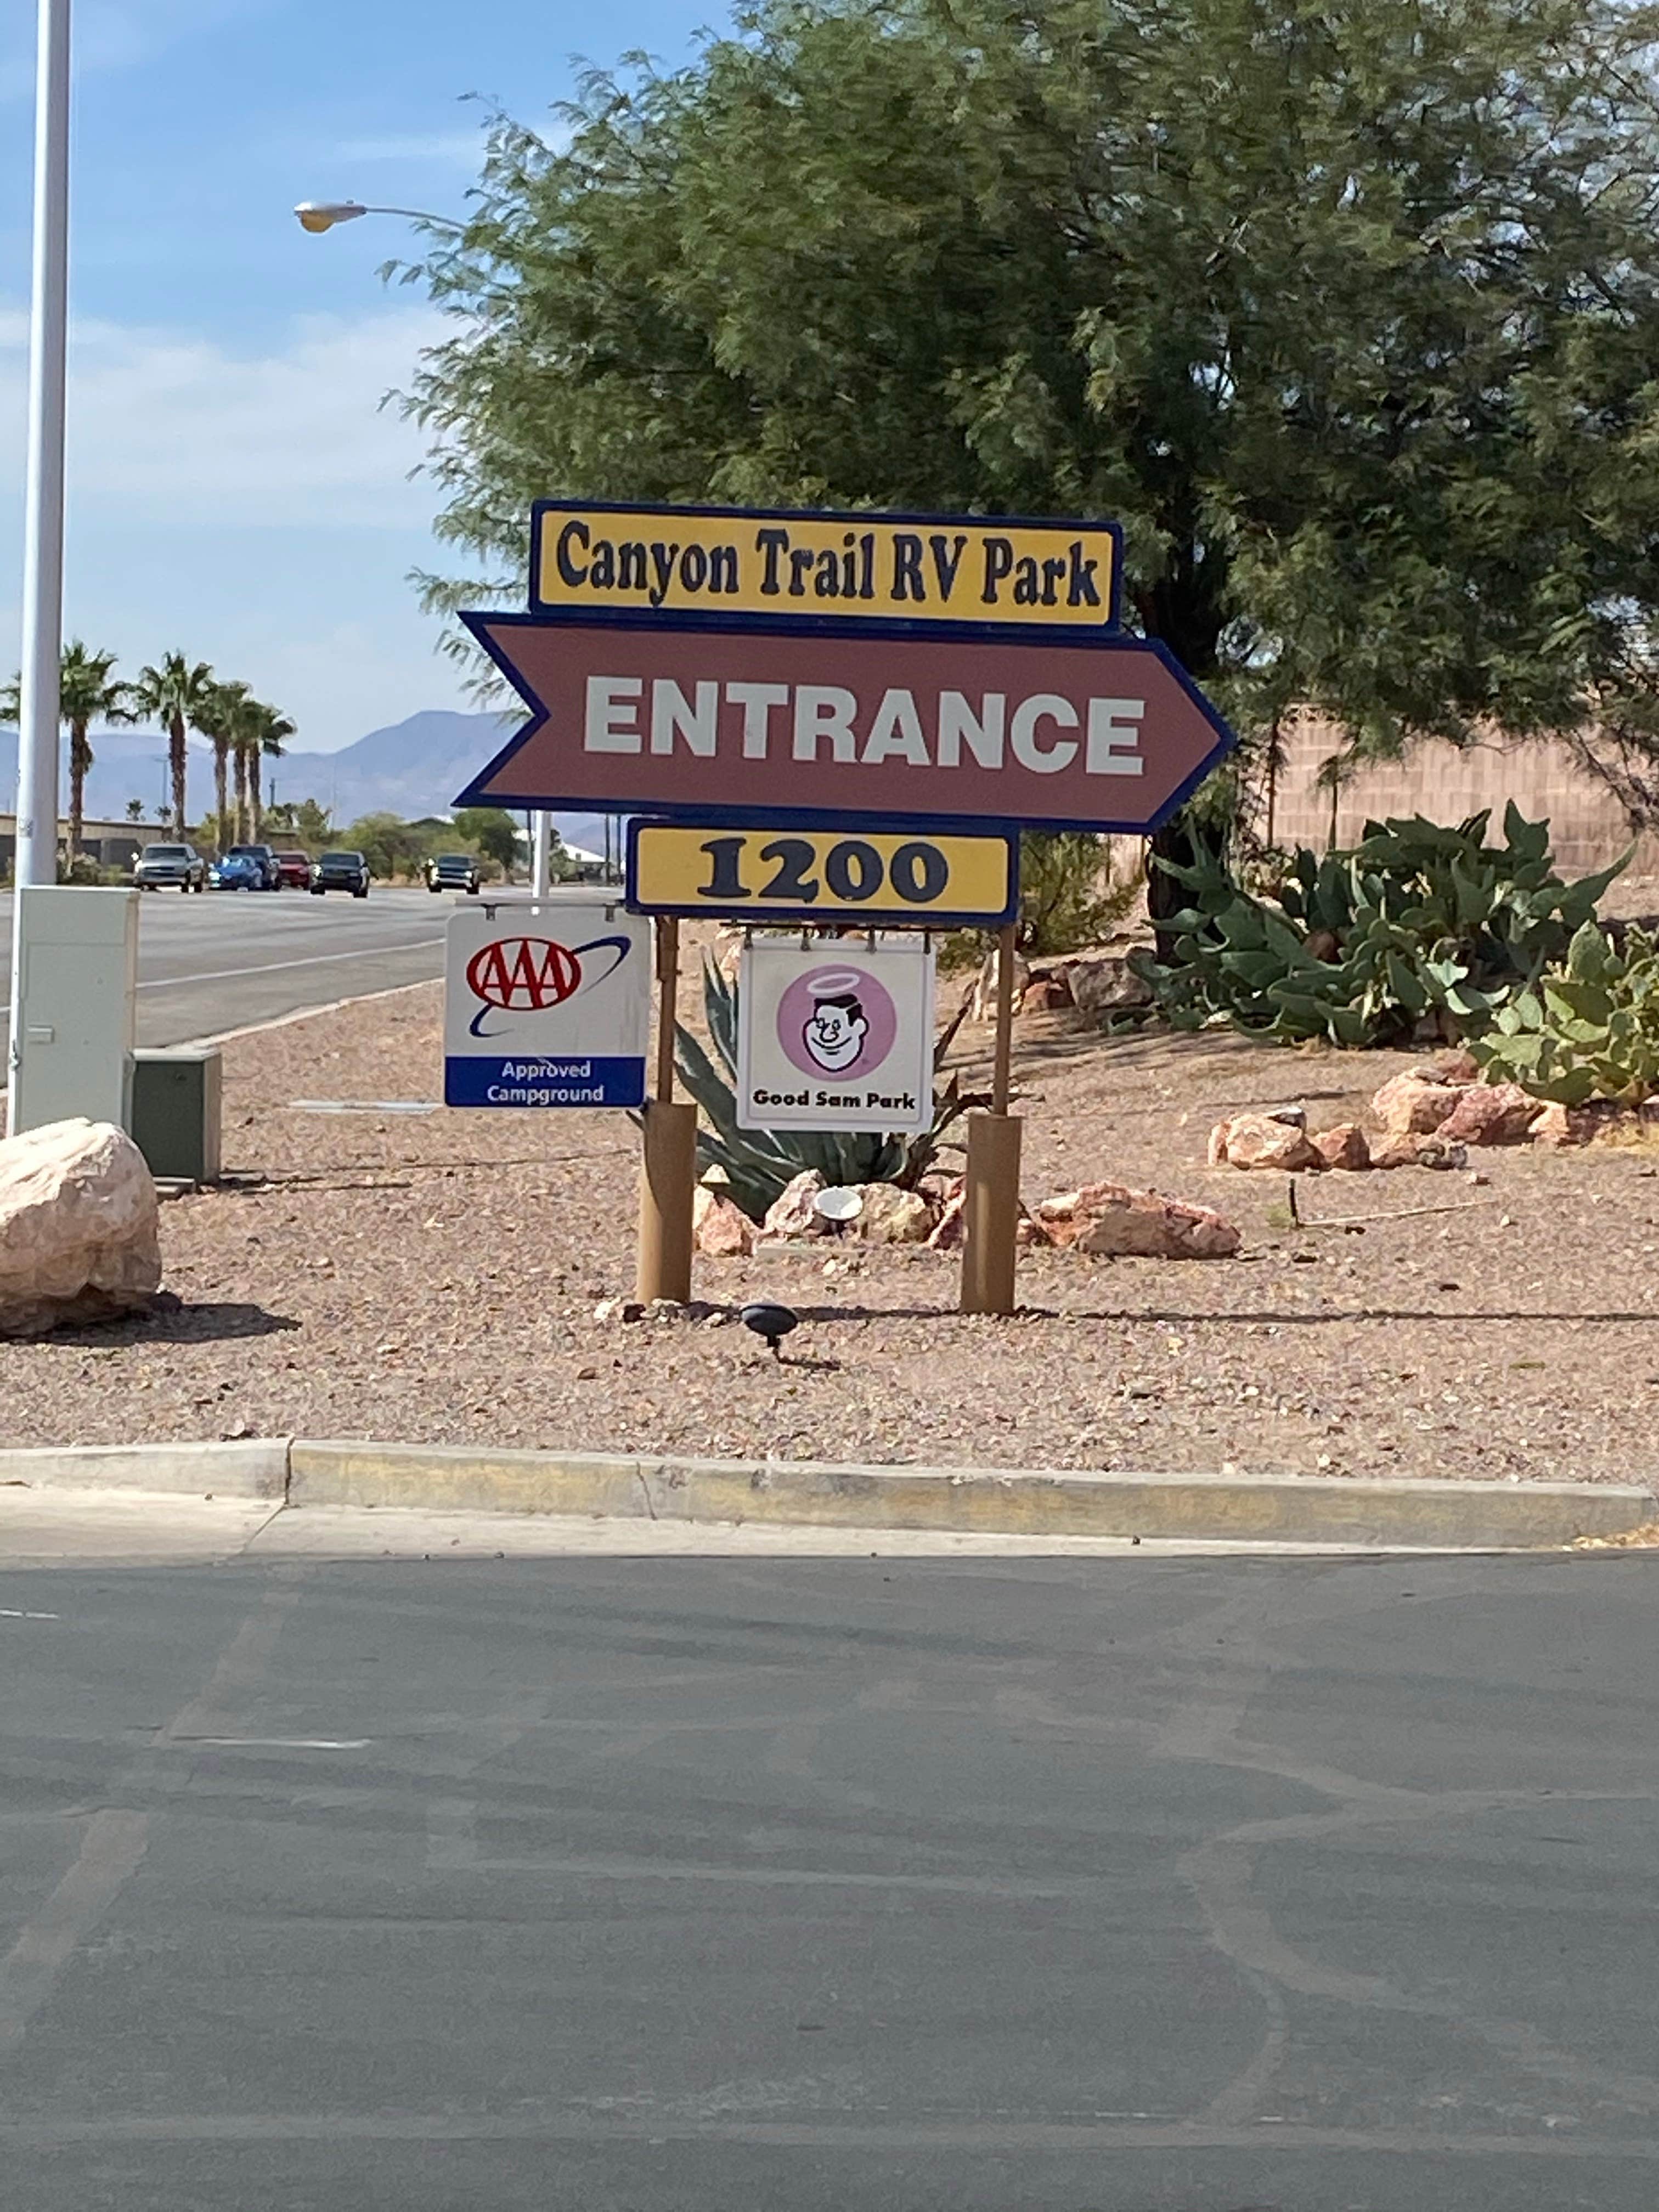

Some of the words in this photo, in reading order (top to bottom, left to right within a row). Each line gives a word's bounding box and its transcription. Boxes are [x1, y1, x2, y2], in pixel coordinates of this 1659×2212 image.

[556, 519, 738, 607] Canyon
[756, 527, 873, 599] Trail
[891, 533, 967, 602] RV
[982, 537, 1101, 607] Park
[584, 674, 1146, 776] ENTRANCE
[697, 837, 949, 903] 1200
[476, 939, 568, 1009] AAA
[487, 1084, 604, 1105] Campground
[501, 1060, 591, 1082] Approved
[753, 1088, 810, 1108] Good
[815, 1090, 861, 1109] Sam
[866, 1091, 916, 1110] Park
